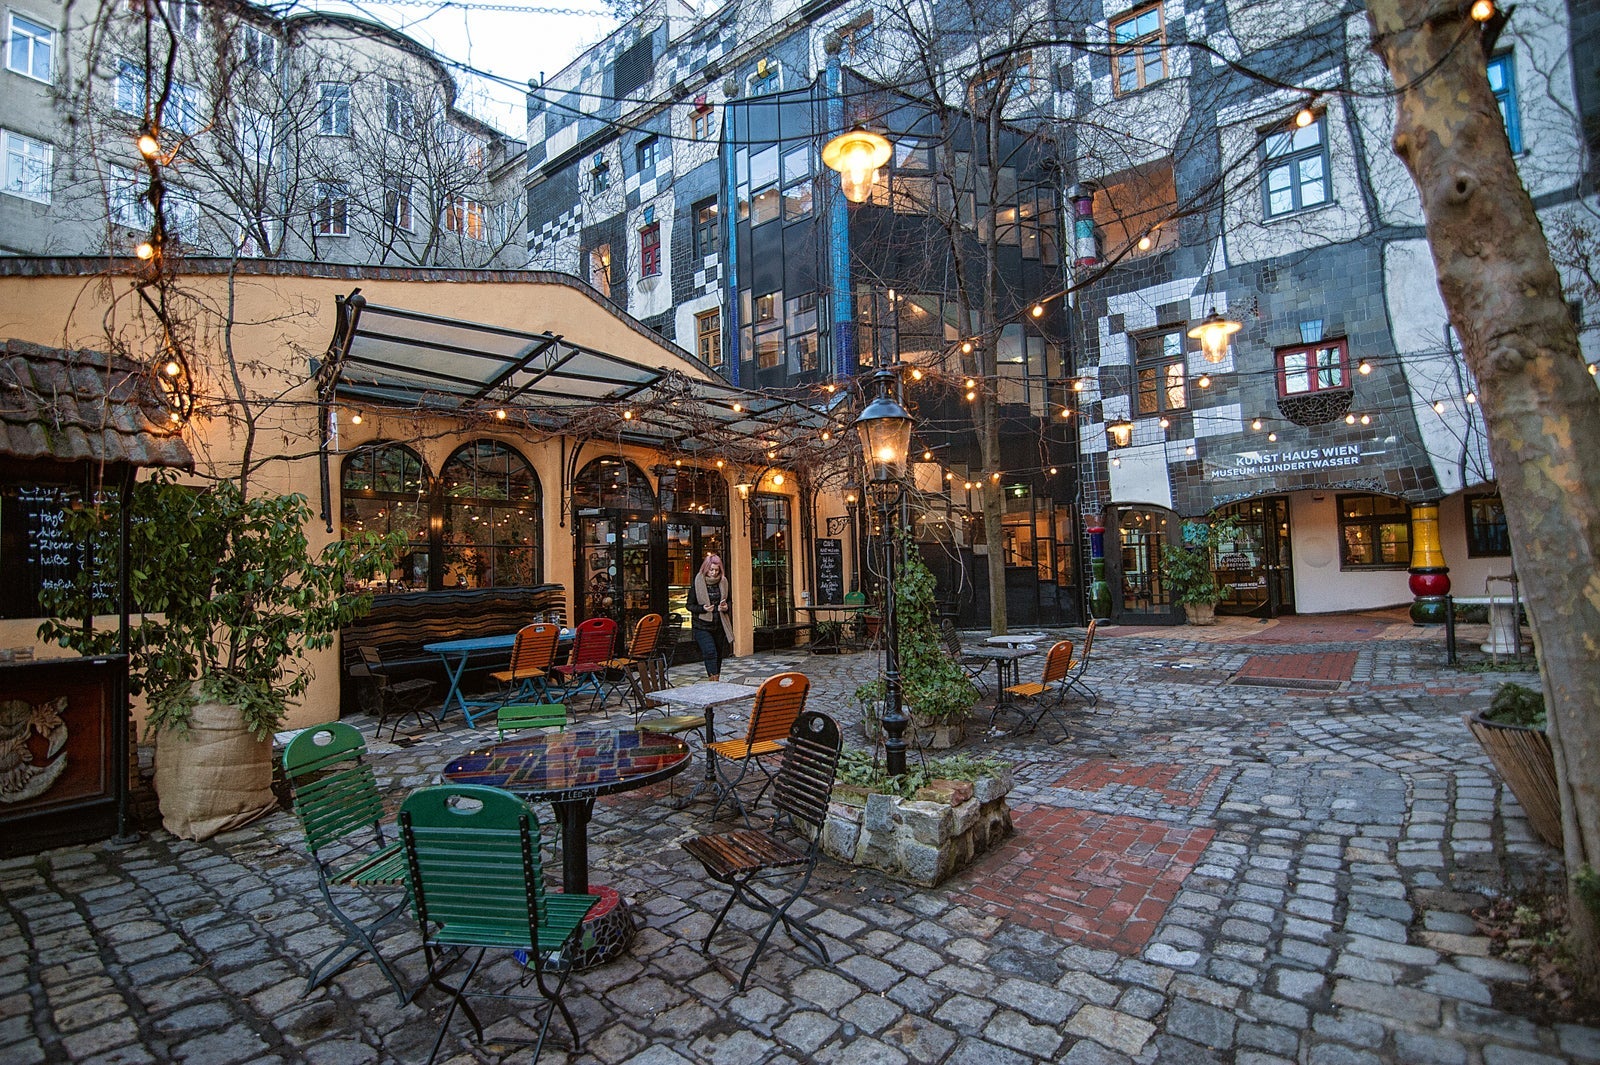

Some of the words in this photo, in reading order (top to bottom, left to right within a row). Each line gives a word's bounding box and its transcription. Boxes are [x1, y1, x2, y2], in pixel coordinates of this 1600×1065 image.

[1236, 453, 1279, 467] KUNST
[1282, 449, 1319, 462] HAUS
[1322, 445, 1359, 457] WIEN
[1211, 466, 1256, 478] MUSEUM
[1260, 457, 1359, 473] HUNDERTWASSER
